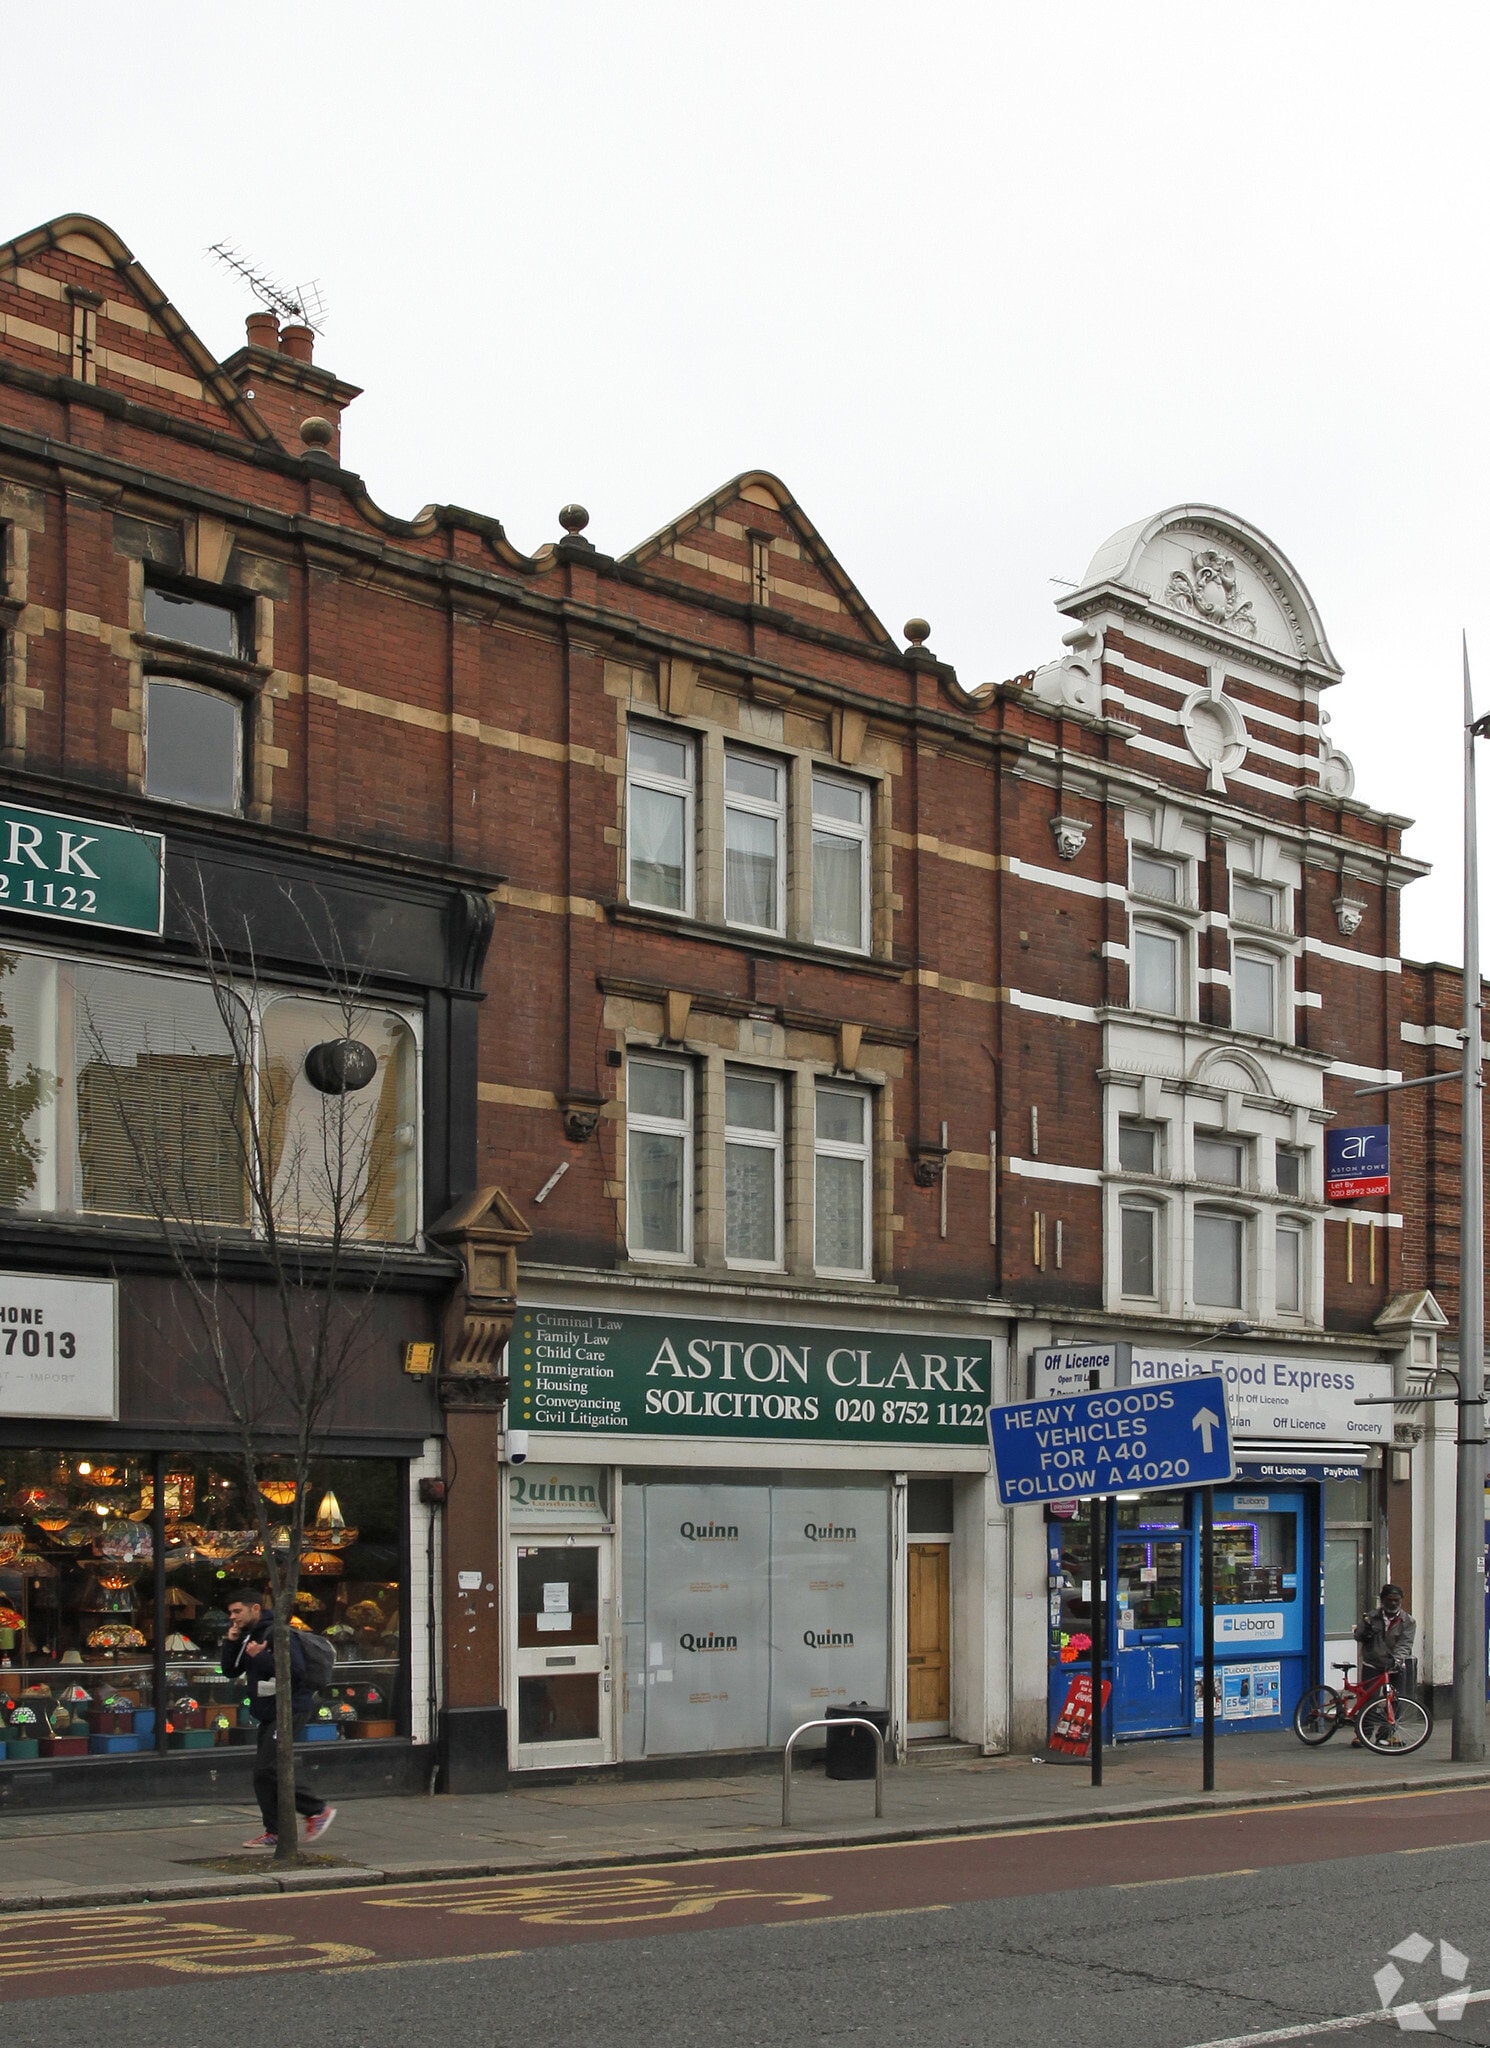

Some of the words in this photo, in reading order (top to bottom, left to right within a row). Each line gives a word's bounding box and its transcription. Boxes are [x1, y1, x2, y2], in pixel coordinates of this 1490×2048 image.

[22, 879, 97, 914] 1122
[1344, 1181, 1354, 1189] By
[1346, 1188, 1365, 1196] 8992
[1366, 1186, 1385, 1194] 3600
[536, 1313, 592, 1328] Criminal
[597, 1318, 623, 1330] Law
[2, 1329, 76, 1359] 7013
[536, 1329, 580, 1346] Family
[584, 1333, 610, 1345] Law
[536, 1345, 571, 1359] Child
[575, 1348, 605, 1361] Care
[1044, 1354, 1062, 1370] Off
[1065, 1354, 1110, 1369] Licence
[536, 1361, 614, 1378] Immigration
[646, 1337, 811, 1384] ASTON
[826, 1348, 984, 1393] CLARK
[30, 1373, 76, 1383] IMPORT
[536, 1378, 588, 1395] Housing
[1058, 1374, 1072, 1384] Open
[1074, 1374, 1082, 1382] Till
[1274, 1364, 1355, 1392] Express
[535, 1394, 621, 1413] Conveyancing
[645, 1389, 819, 1421] SOLICITORS
[835, 1398, 876, 1423] 020
[882, 1400, 929, 1425] 8752
[937, 1403, 985, 1427] 1122
[1246, 1395, 1258, 1403] Off
[1260, 1396, 1289, 1405] Licence
[535, 1410, 566, 1423] Civil
[570, 1412, 628, 1427] Litigation
[1004, 1404, 1076, 1430] HEAVY
[1087, 1390, 1175, 1418] GOODS
[1035, 1417, 1148, 1448] VEHICLES
[1273, 1418, 1288, 1428] Off
[1291, 1419, 1326, 1430] Licence
[1347, 1421, 1382, 1435] Grocery
[1040, 1449, 1085, 1470] FOR
[1261, 1465, 1273, 1474] Off
[1275, 1466, 1306, 1475] Licence
[1323, 1467, 1358, 1477] PayPoint
[510, 1476, 596, 1505] Quinn
[1005, 1470, 1096, 1497] FOLLOW
[680, 1520, 738, 1541] Quinn
[804, 1522, 856, 1541] Quinn
[1234, 1618, 1275, 1630] Lebara
[680, 1632, 737, 1652] Quinn
[803, 1627, 854, 1648] Quinn
[360, 1878, 833, 1925] BUS
